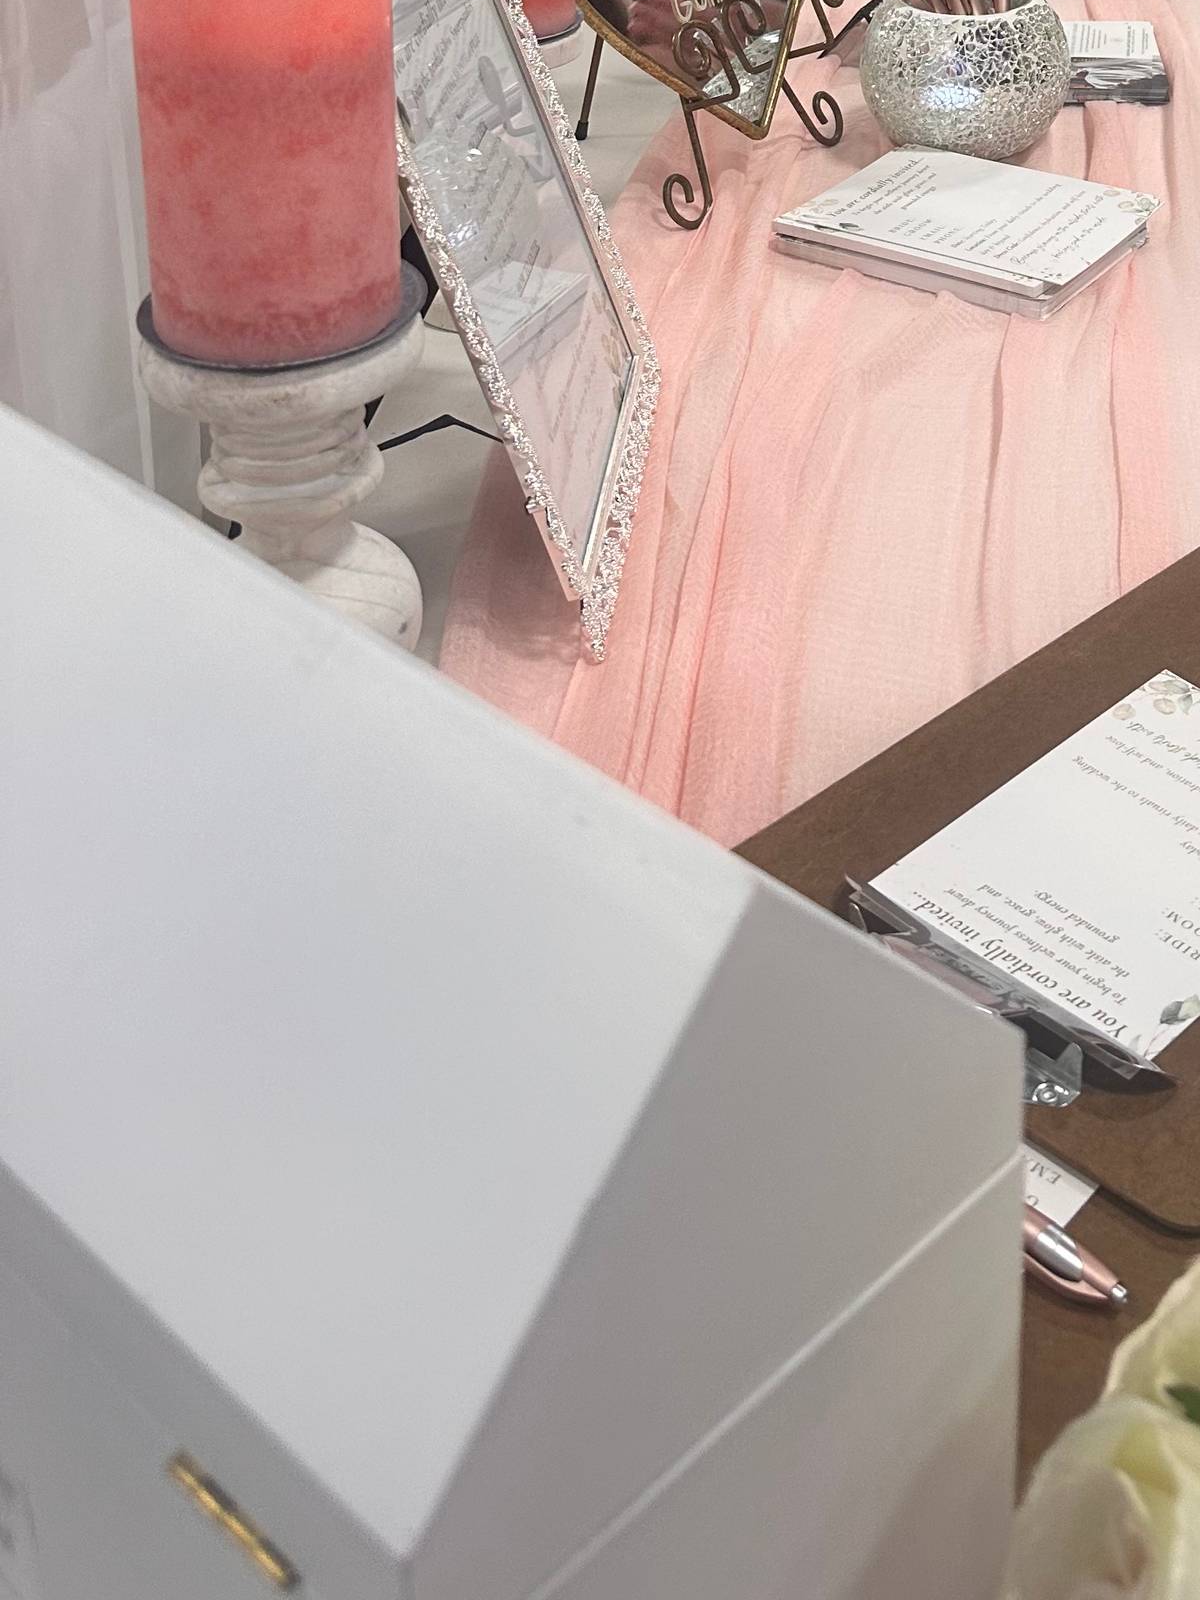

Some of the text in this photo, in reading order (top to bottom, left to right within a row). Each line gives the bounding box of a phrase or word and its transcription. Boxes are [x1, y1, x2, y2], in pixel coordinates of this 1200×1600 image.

[1104, 735, 1144, 759] self-love
[1071, 755, 1111, 782] wedding
[1139, 757, 1164, 769] and
[1110, 780, 1128, 792] the
[1127, 790, 1141, 799] to
[1139, 796, 1172, 817] rituals
[1171, 815, 1200, 833] daily
[1033, 890, 1121, 944] grounded energy.
[976, 884, 1131, 978] the aisle with glow, grace, and
[943, 888, 1127, 1006] To begin your wellness journey down
[912, 891, 1128, 1039] You are cordially invited...
